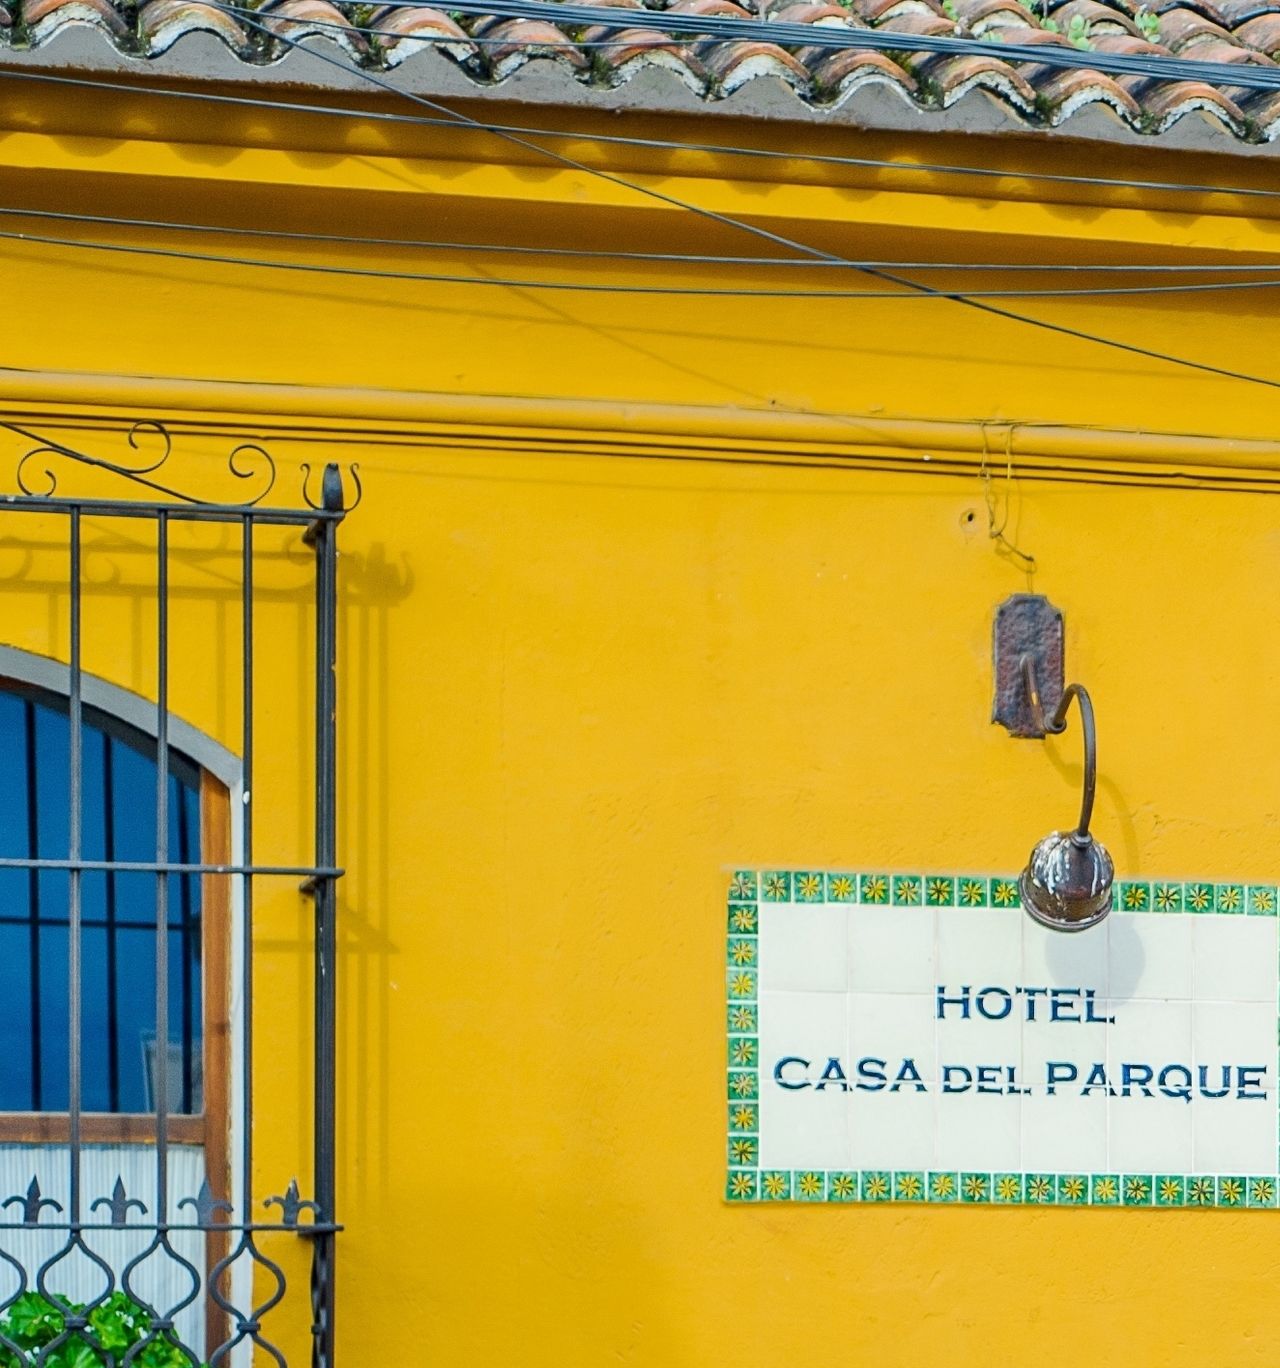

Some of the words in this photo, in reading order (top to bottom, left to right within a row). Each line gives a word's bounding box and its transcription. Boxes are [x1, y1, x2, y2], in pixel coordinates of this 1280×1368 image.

[934, 985, 1115, 1024] HOTEL
[774, 1057, 928, 1092] CASA
[942, 1065, 1032, 1096] DEL
[1046, 1061, 1268, 1103] PARQUE
